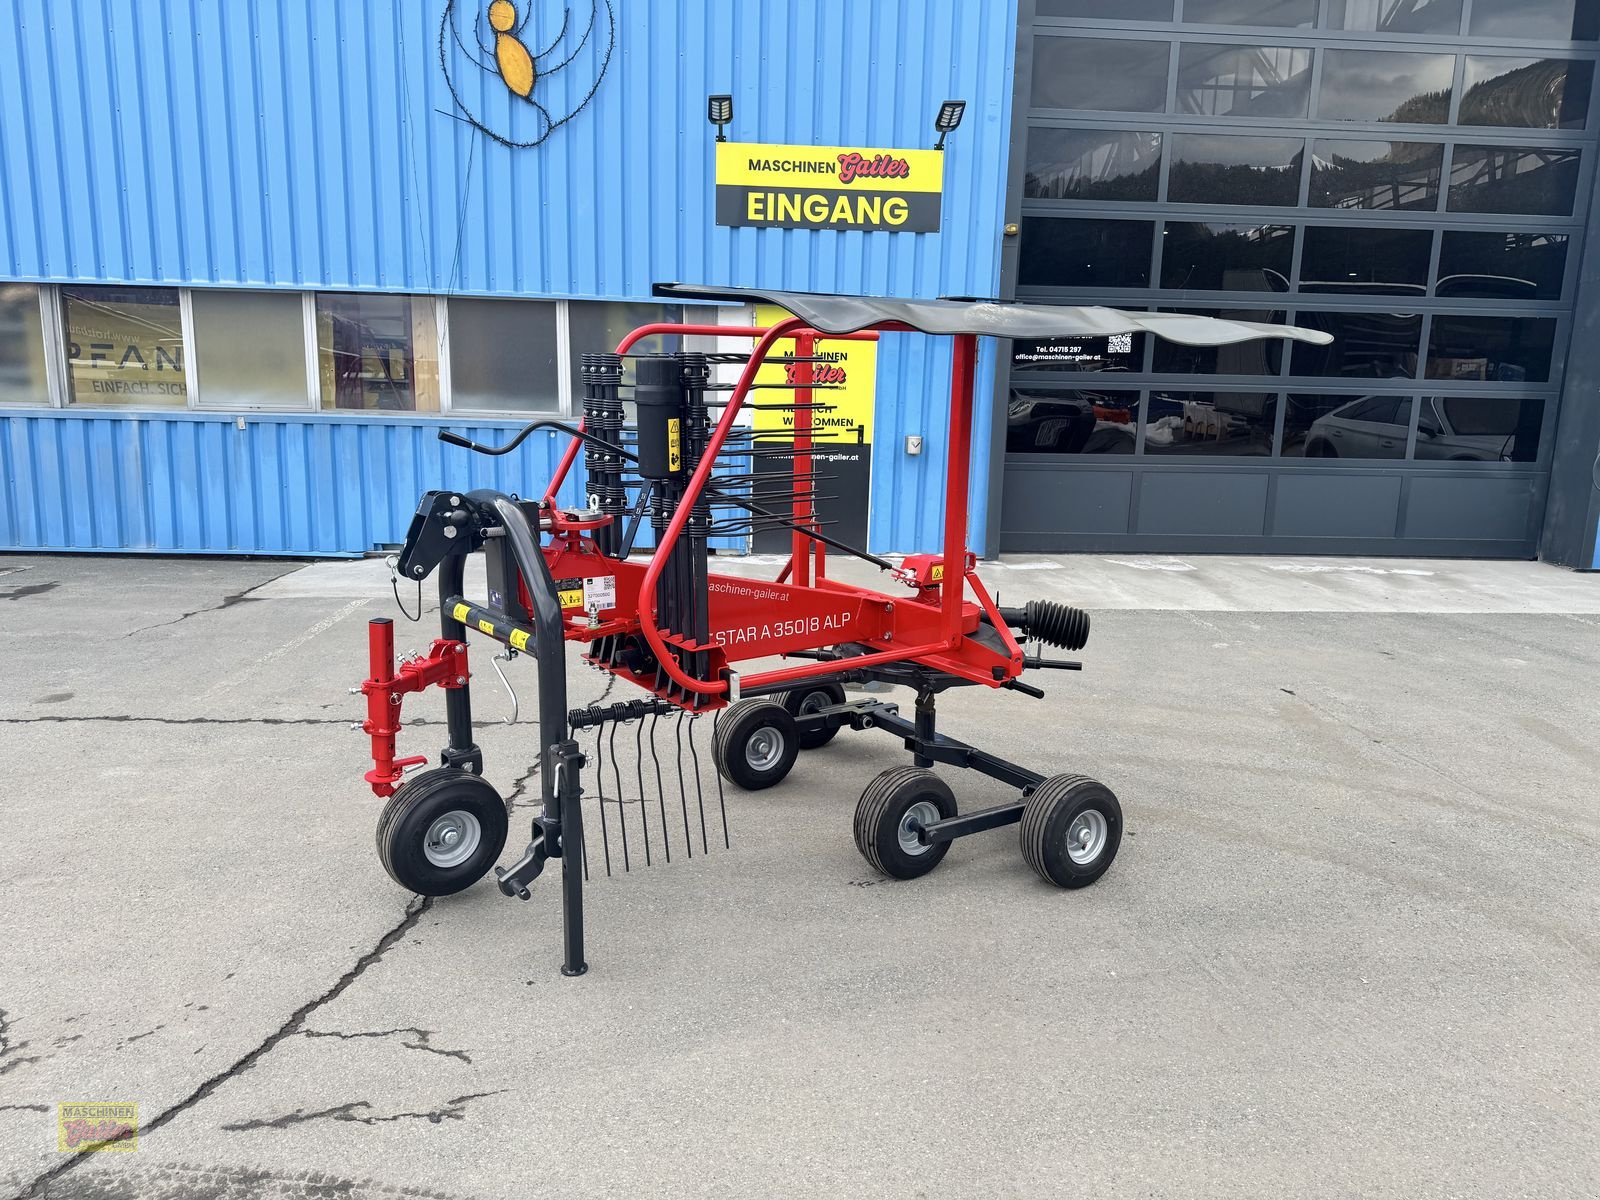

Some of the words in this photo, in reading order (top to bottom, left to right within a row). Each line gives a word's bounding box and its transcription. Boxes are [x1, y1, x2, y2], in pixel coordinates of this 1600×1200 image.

[748, 159, 836, 174] MASCHINEN
[837, 152, 910, 184] Gailer
[747, 191, 909, 225] EINGANG
[760, 624, 775, 640] A
[823, 612, 851, 629] ALP
